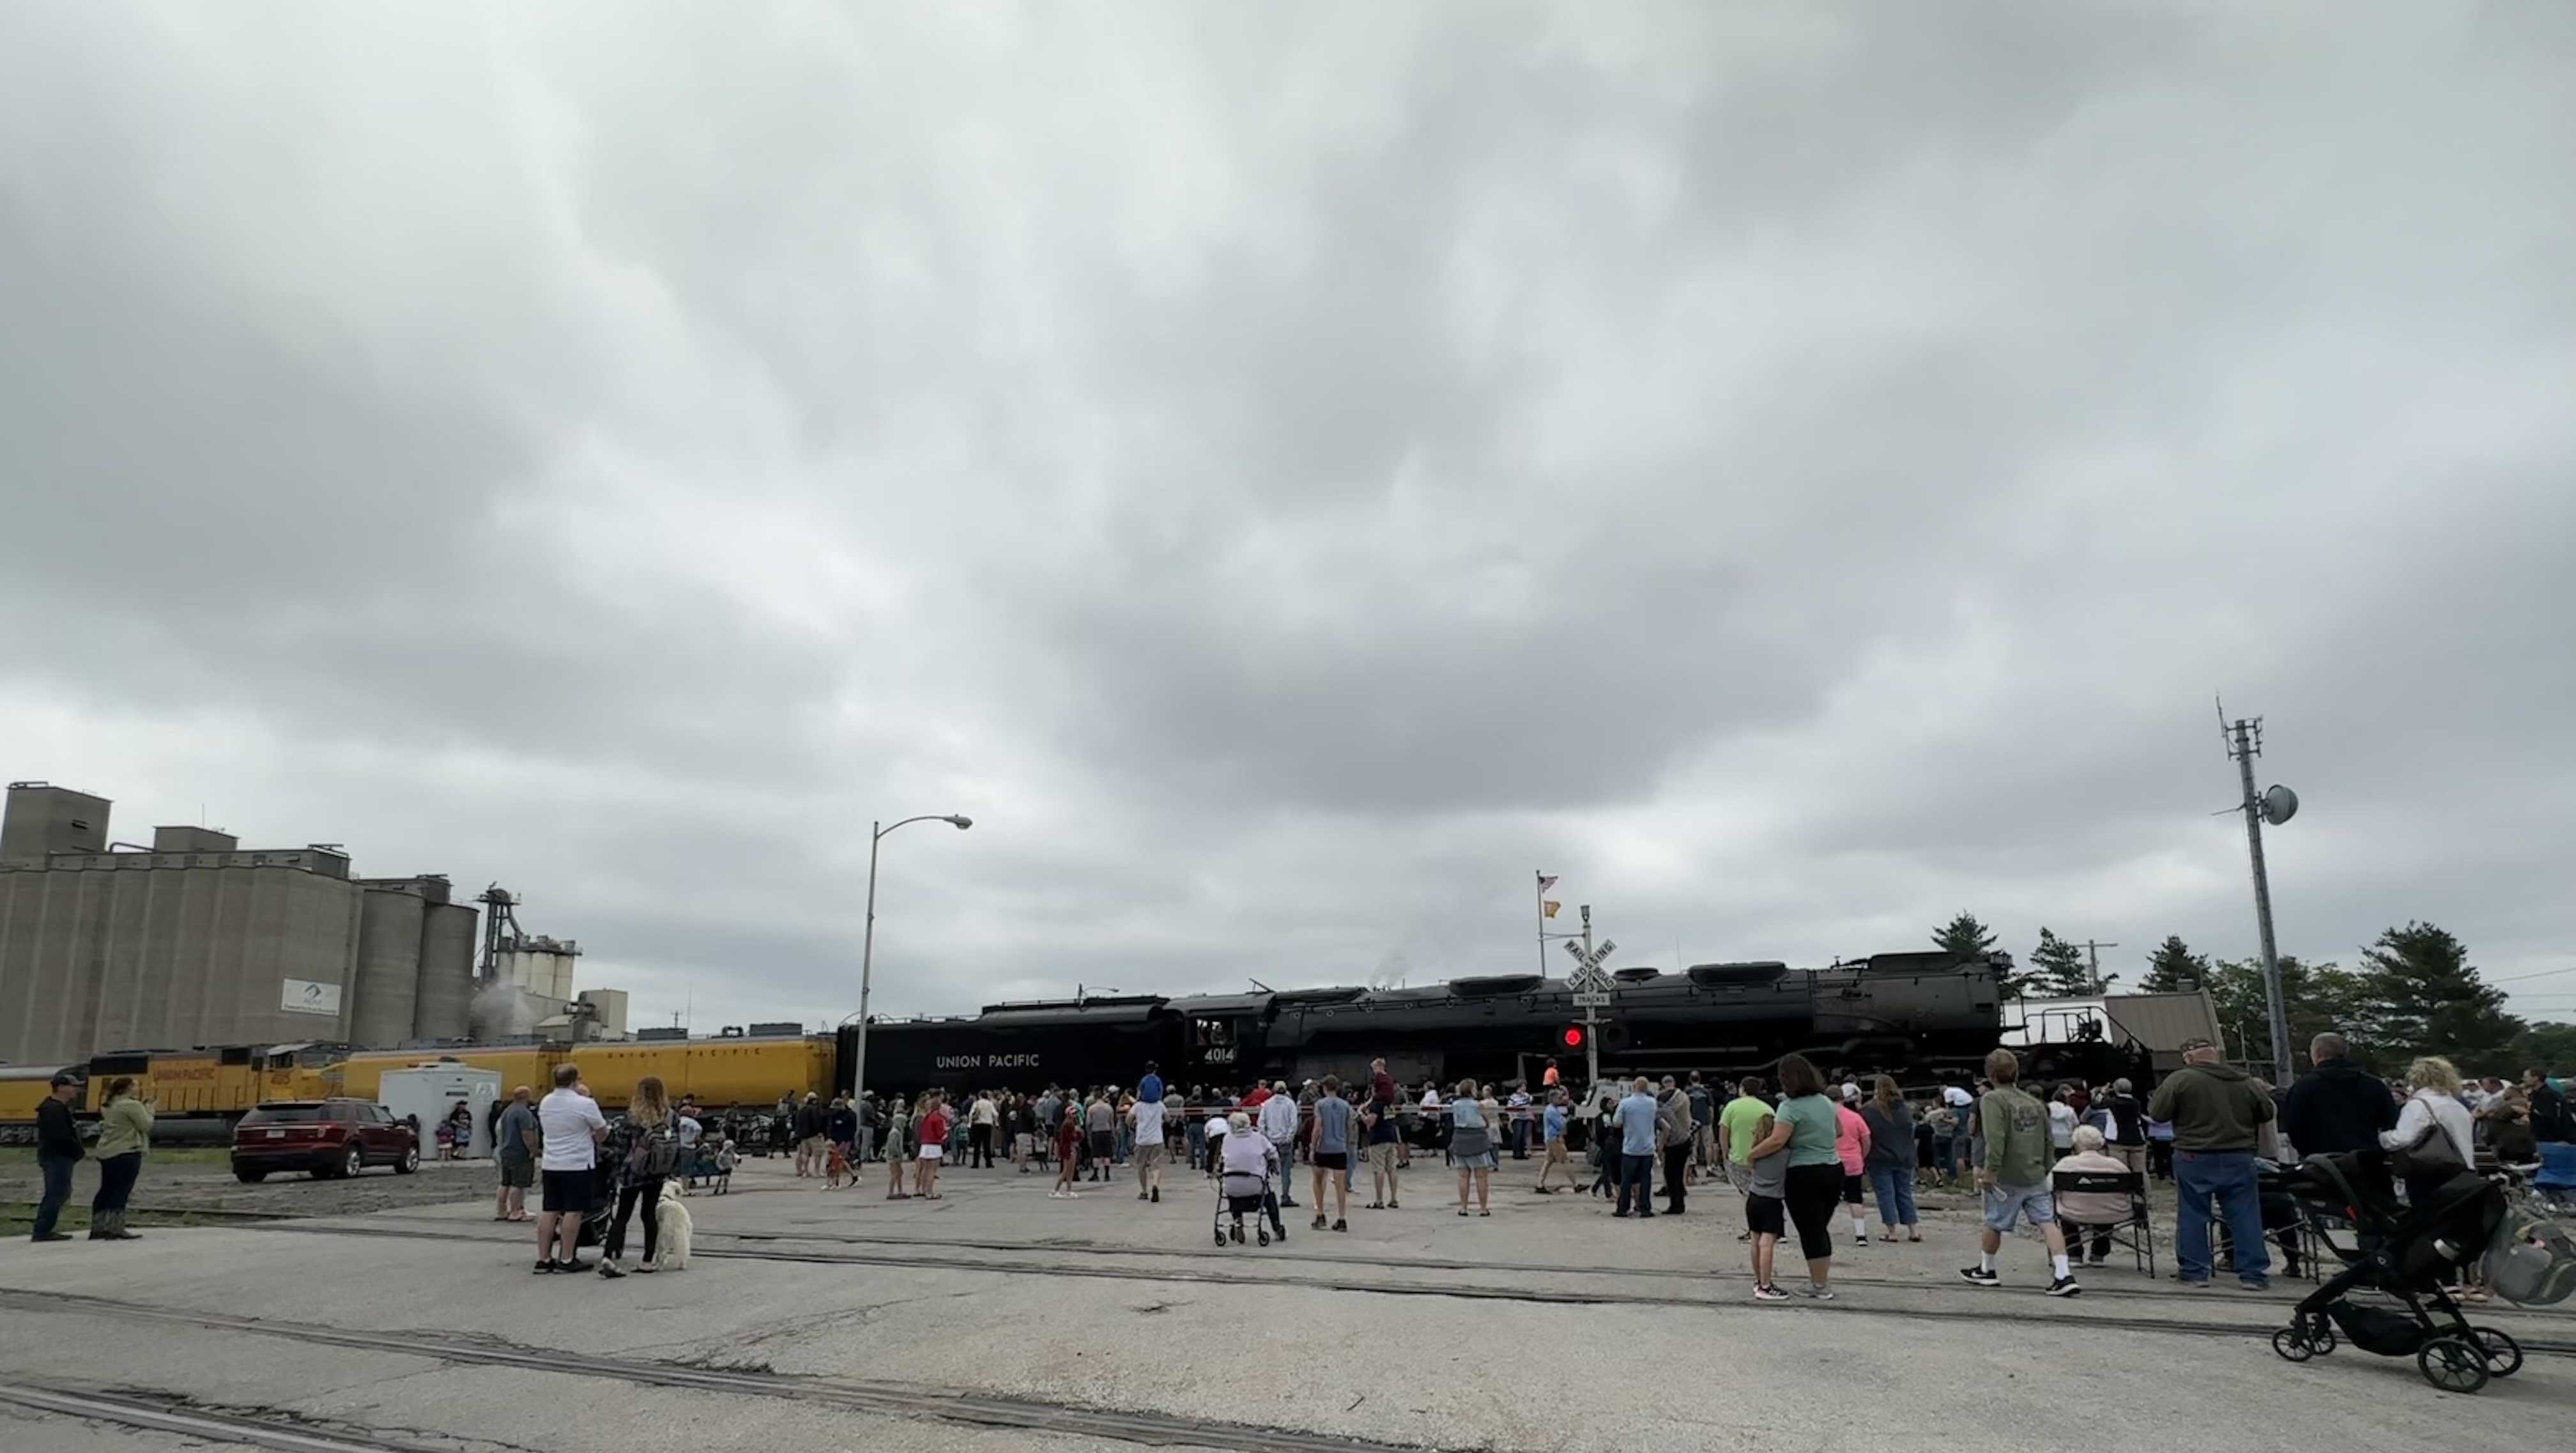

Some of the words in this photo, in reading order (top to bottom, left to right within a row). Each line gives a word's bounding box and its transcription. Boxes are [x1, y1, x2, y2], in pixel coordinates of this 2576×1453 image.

[1567, 941, 1584, 961] RAIL
[1593, 967, 1614, 987] ROAD
[1568, 942, 1613, 986] CROSSING
[1588, 983, 1595, 992] 3
[686, 1047, 760, 1057] PACIFIC
[1204, 1048, 1234, 1061] 4014
[936, 1055, 981, 1068] UNION
[988, 1054, 1039, 1067] PACIFIC
